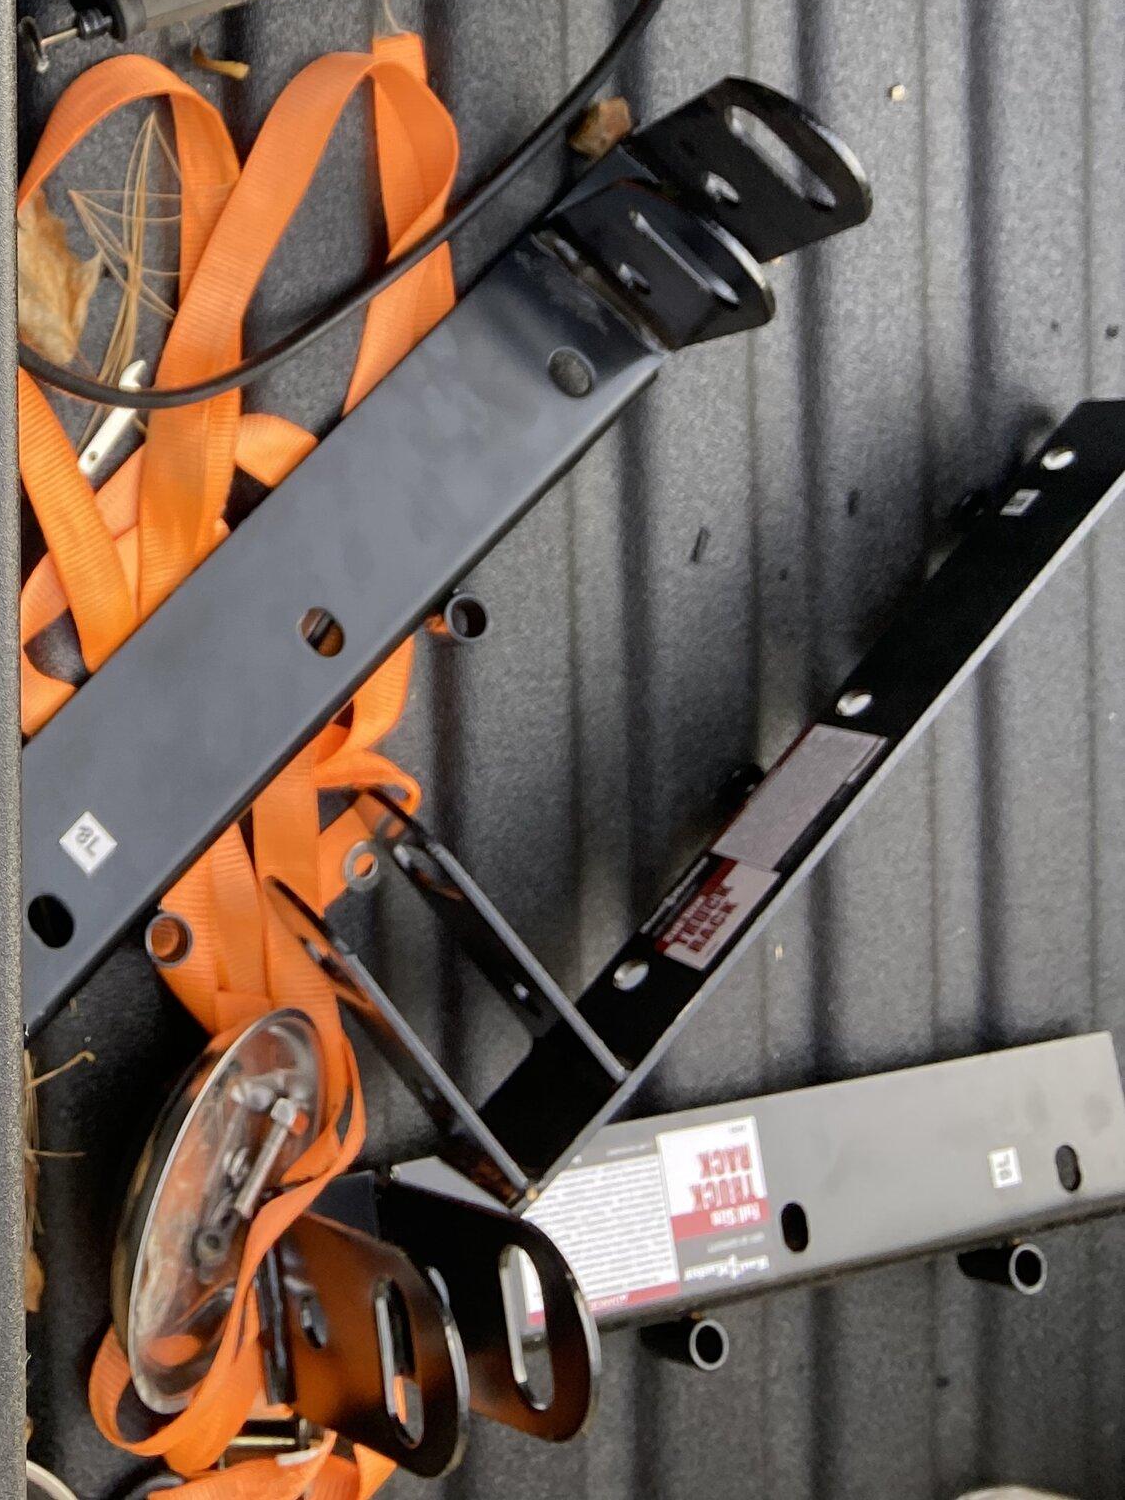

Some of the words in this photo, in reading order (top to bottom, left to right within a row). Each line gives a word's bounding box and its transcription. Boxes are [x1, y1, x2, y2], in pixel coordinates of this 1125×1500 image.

[674, 883, 733, 944] TRUCK
[689, 902, 737, 952] RACK
[698, 1143, 753, 1179] RACK
[689, 1173, 758, 1213] TRUCK
